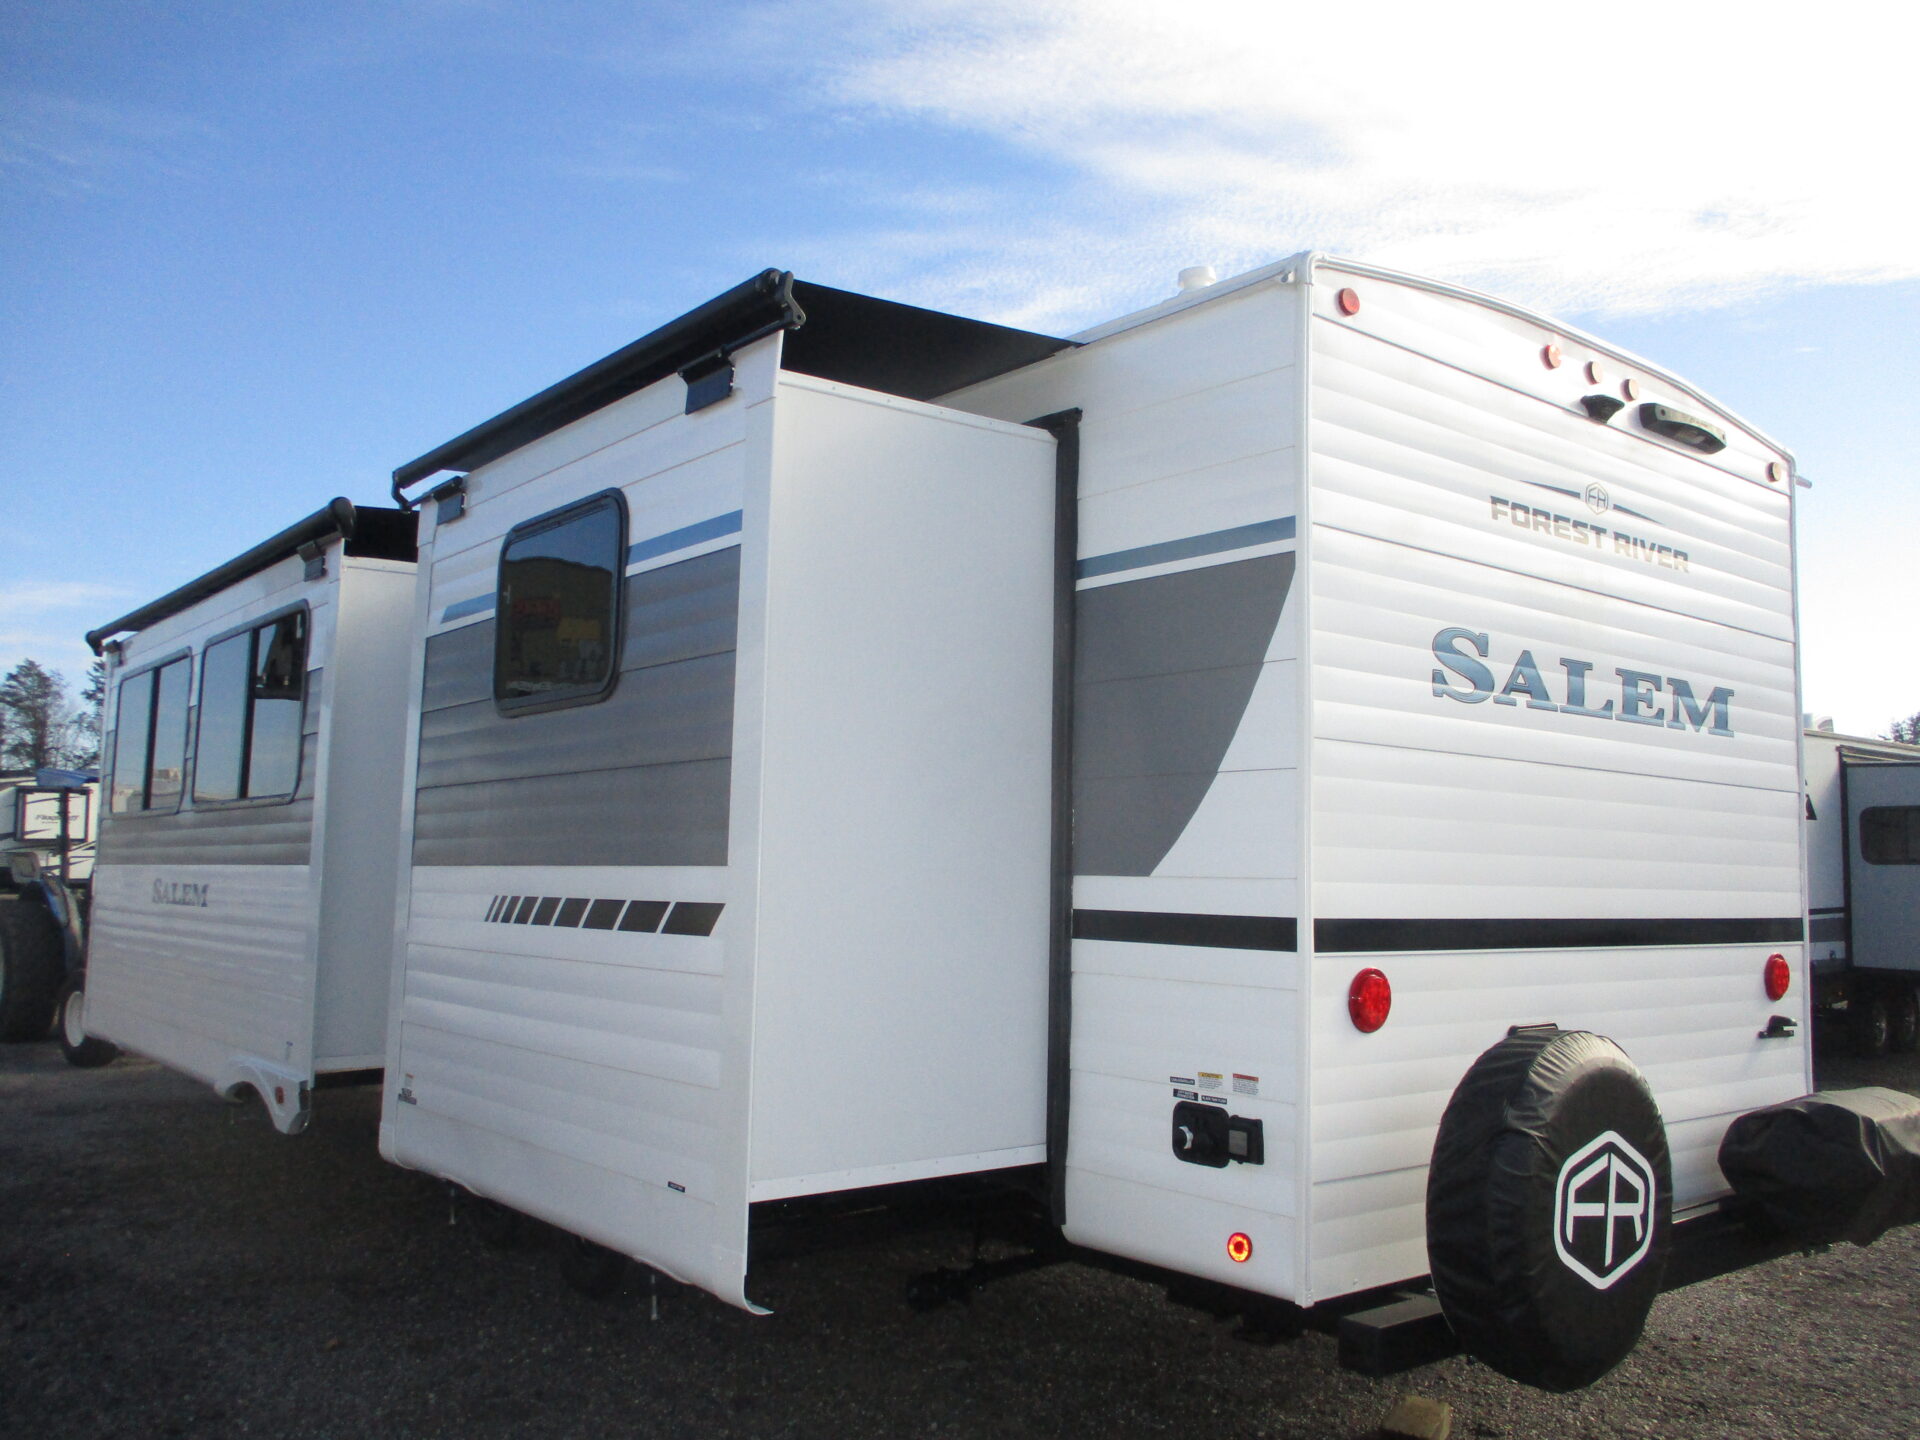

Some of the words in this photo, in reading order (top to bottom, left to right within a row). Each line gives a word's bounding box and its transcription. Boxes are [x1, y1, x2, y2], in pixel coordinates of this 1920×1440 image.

[1490, 495, 1607, 550] FOREST
[1613, 531, 1690, 574] RIVER
[1431, 626, 1735, 738] SALEM
[152, 877, 210, 908] SALEM
